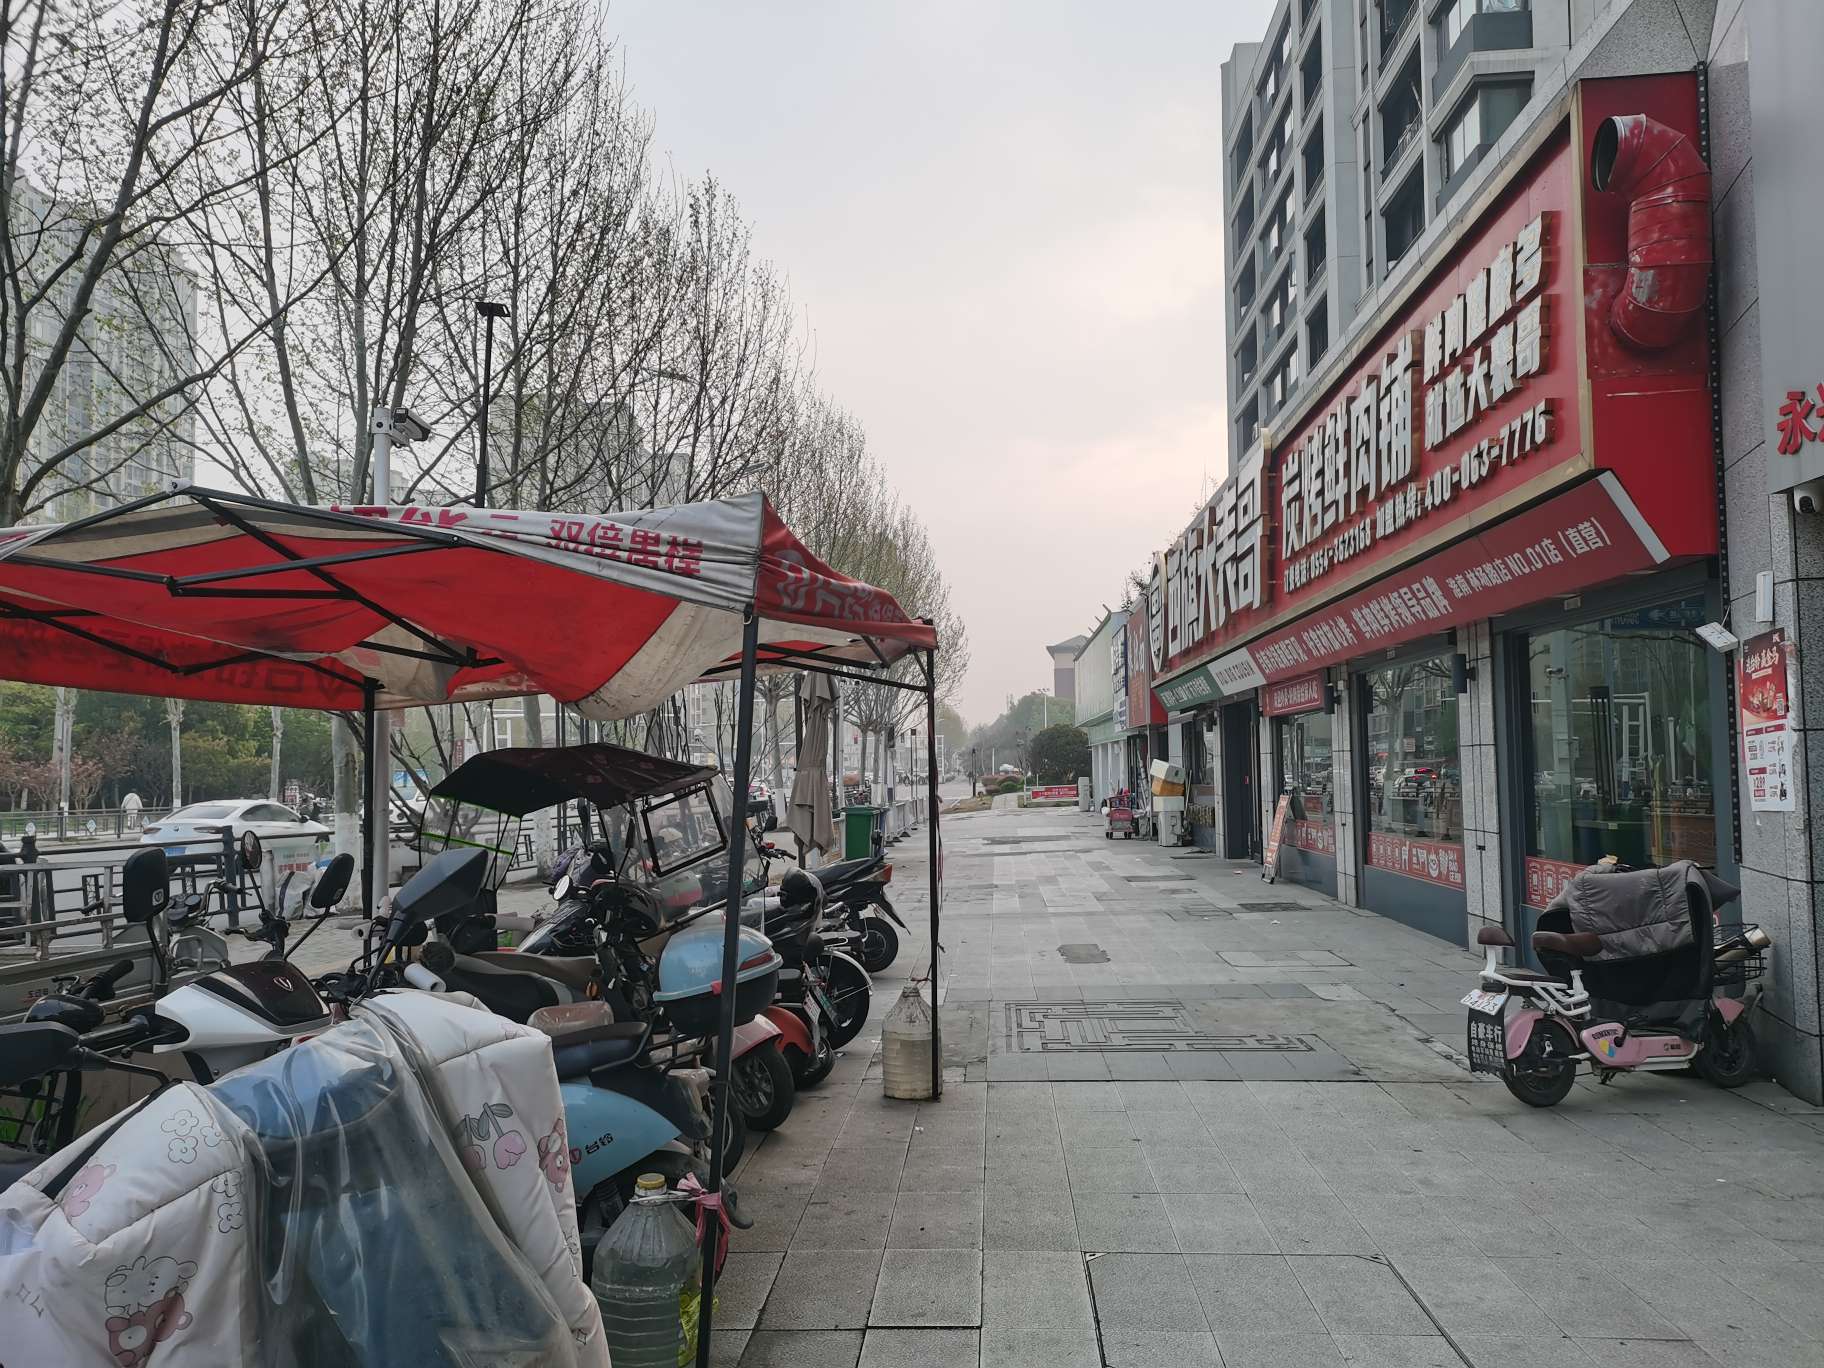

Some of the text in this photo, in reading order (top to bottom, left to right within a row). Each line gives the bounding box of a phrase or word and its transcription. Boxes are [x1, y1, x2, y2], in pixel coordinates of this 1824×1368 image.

[1282, 330, 1412, 560] 炭烤鲜肉铺
[546, 518, 704, 575] 双倍里程
